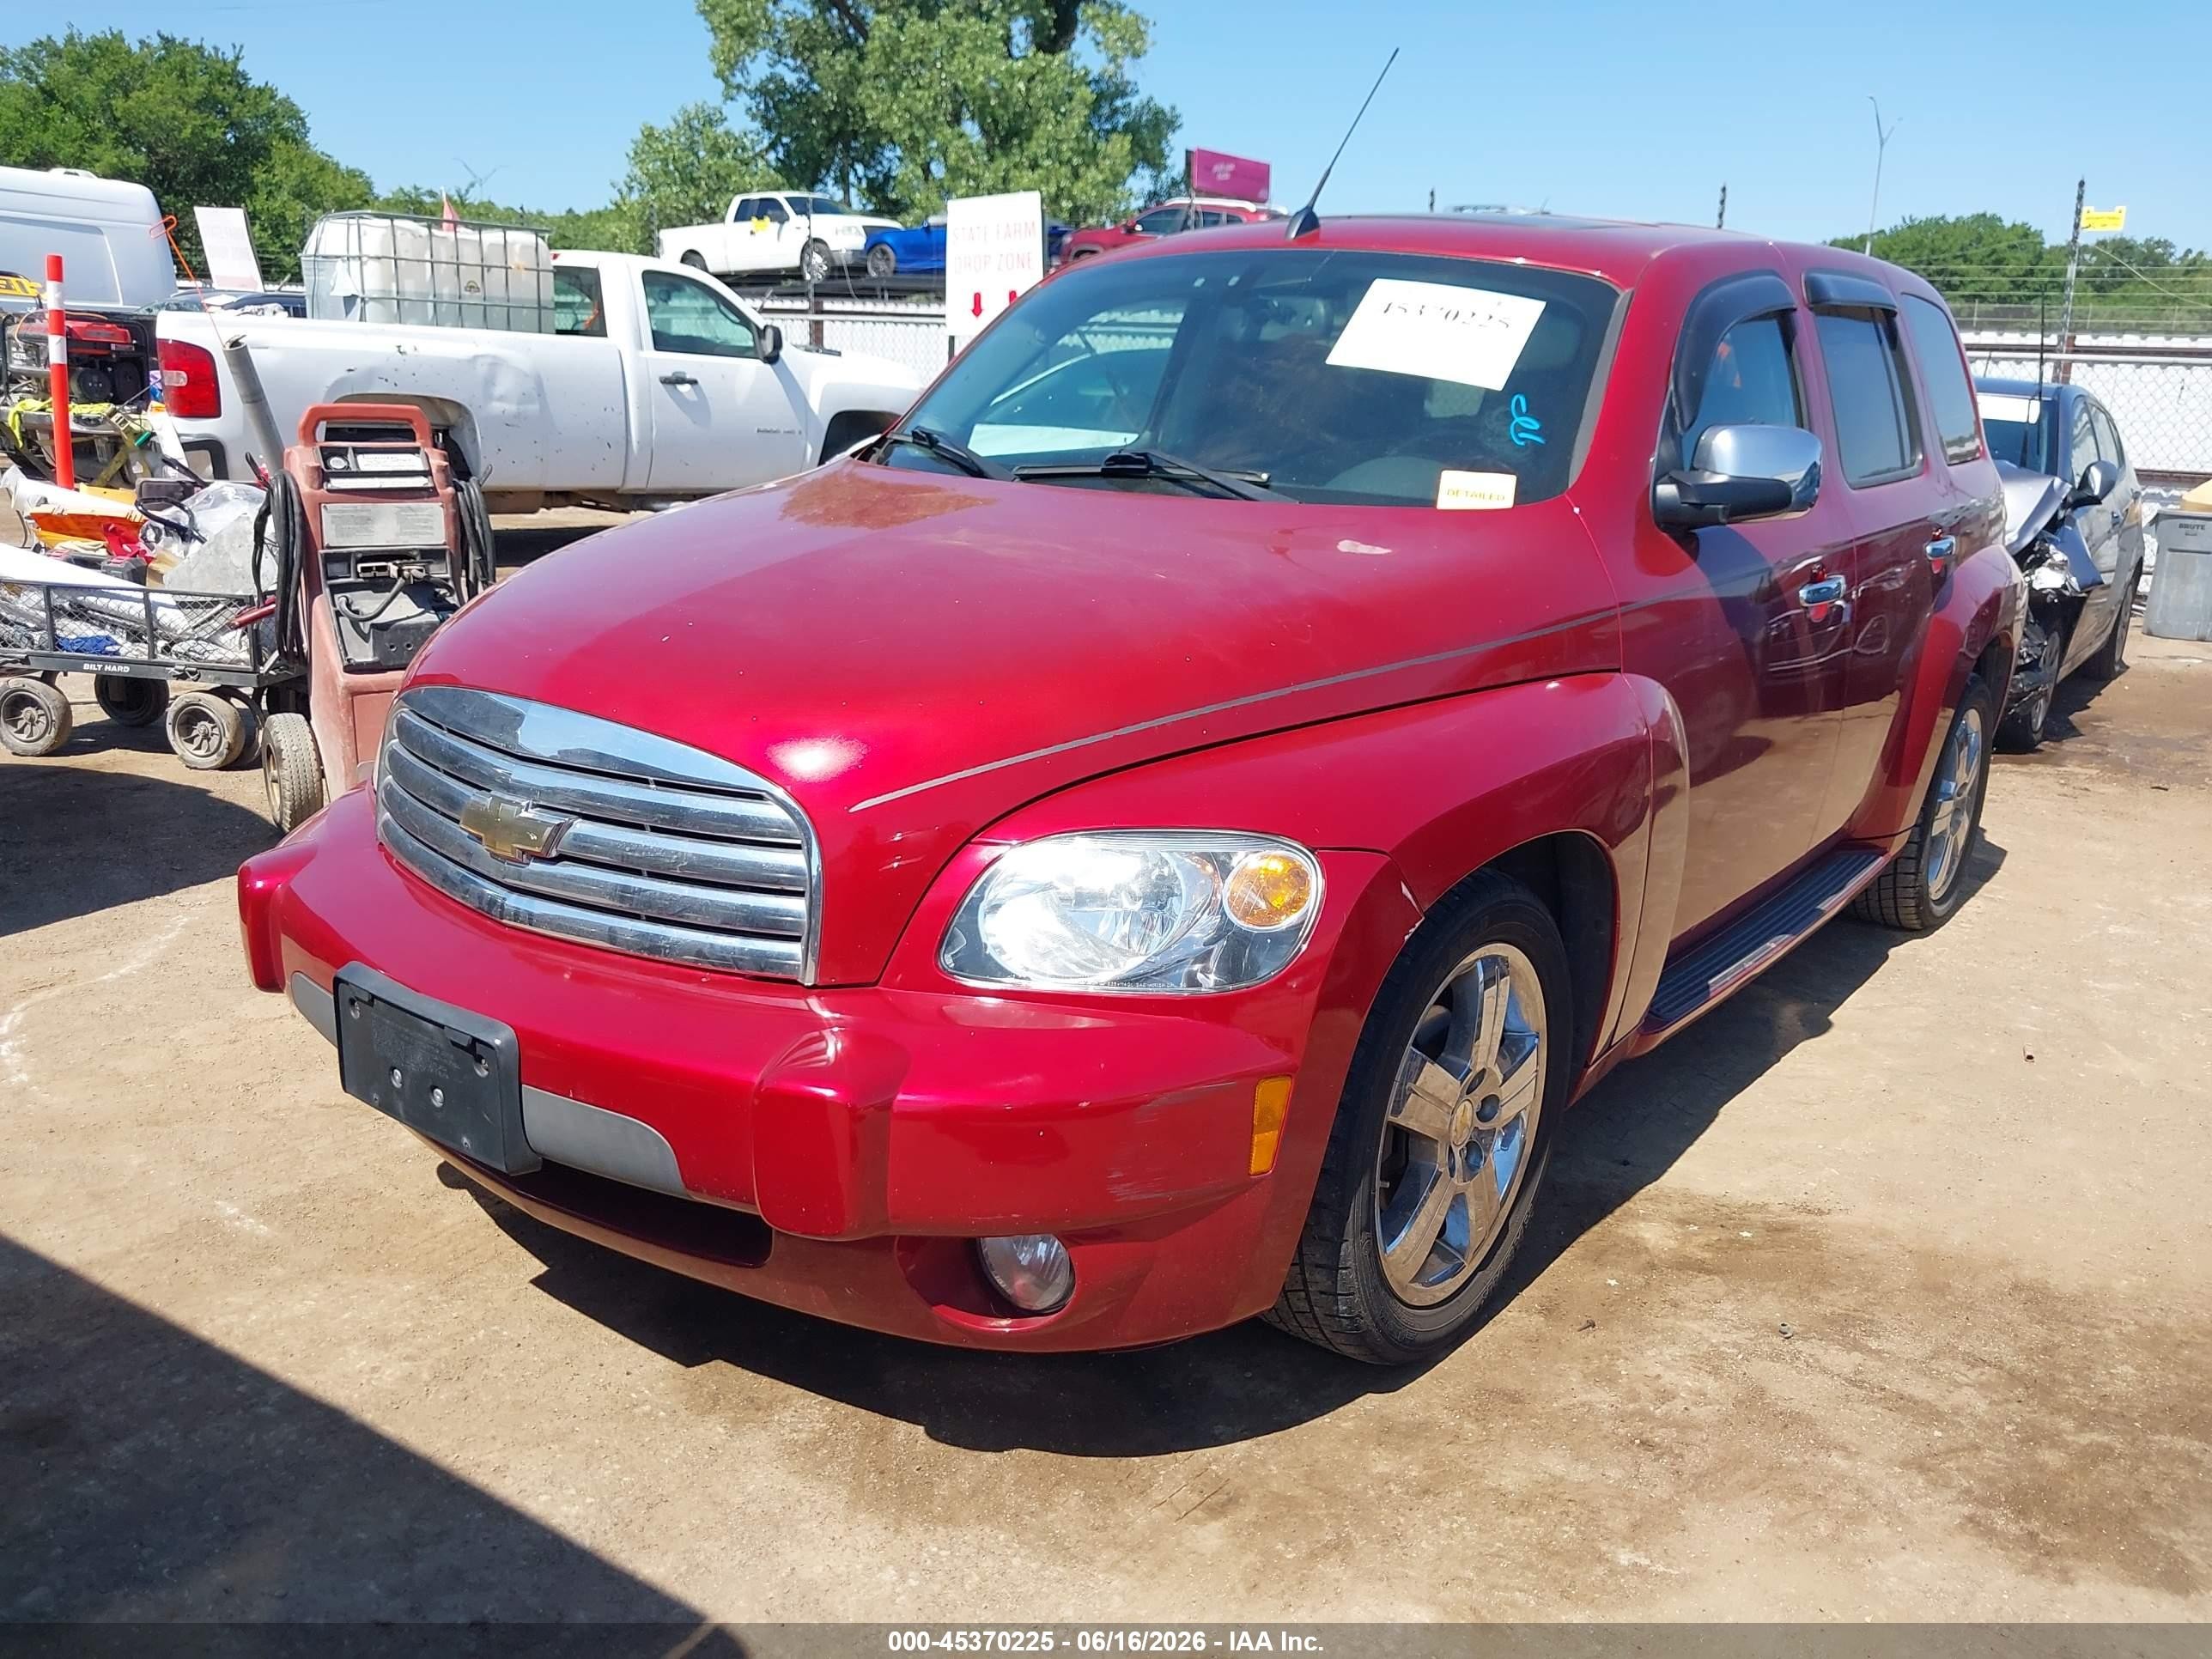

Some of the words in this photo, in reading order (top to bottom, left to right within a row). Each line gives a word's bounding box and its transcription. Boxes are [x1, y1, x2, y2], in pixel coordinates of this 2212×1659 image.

[952, 224, 988, 242] STATE
[996, 220, 1036, 240] FARM
[954, 252, 992, 274] DROP
[996, 250, 1034, 271] ZONE
[1444, 489, 1506, 501] DETAILED
[2179, 522, 2206, 531] BRUTE
[82, 663, 103, 672] BILT
[104, 665, 131, 673] HARD
